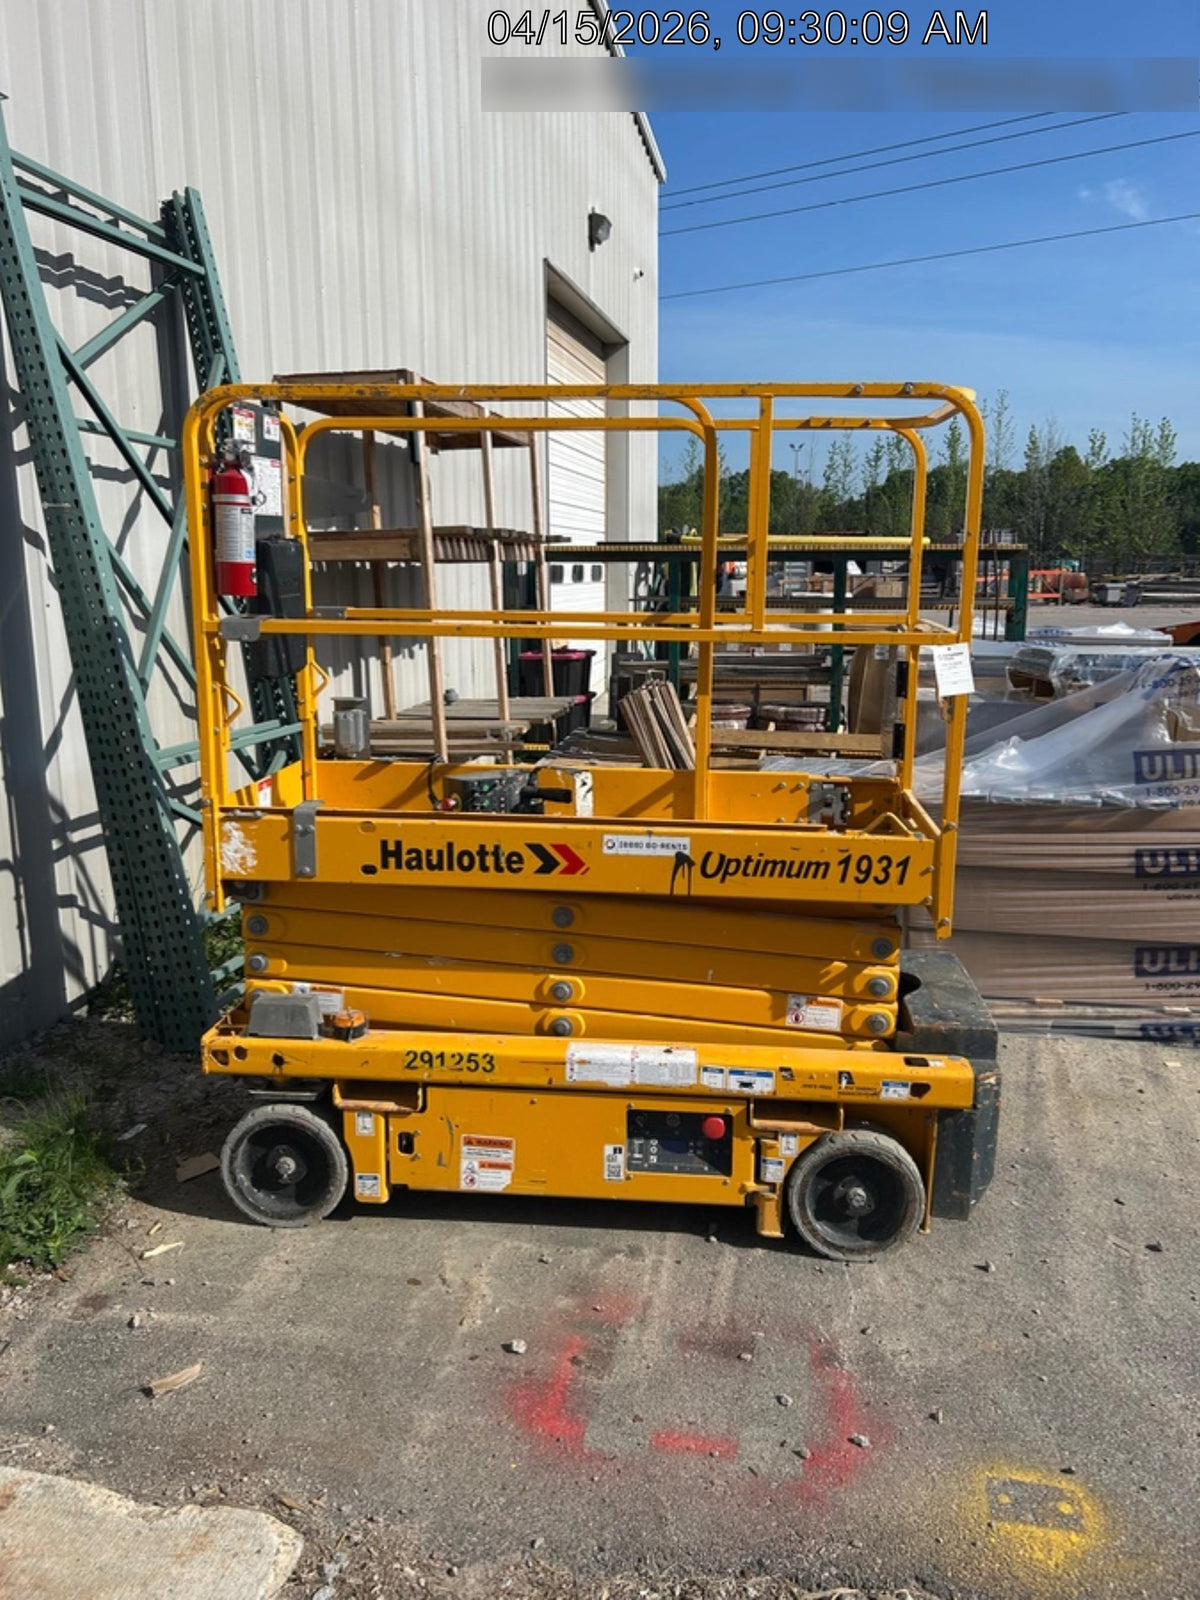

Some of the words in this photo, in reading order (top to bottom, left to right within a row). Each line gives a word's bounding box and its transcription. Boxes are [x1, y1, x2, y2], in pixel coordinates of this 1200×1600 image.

[380, 839, 525, 874] Haulotte
[645, 841, 688, 851] GO-RENTS
[837, 853, 912, 886] 1931
[404, 1049, 495, 1073] 291253
